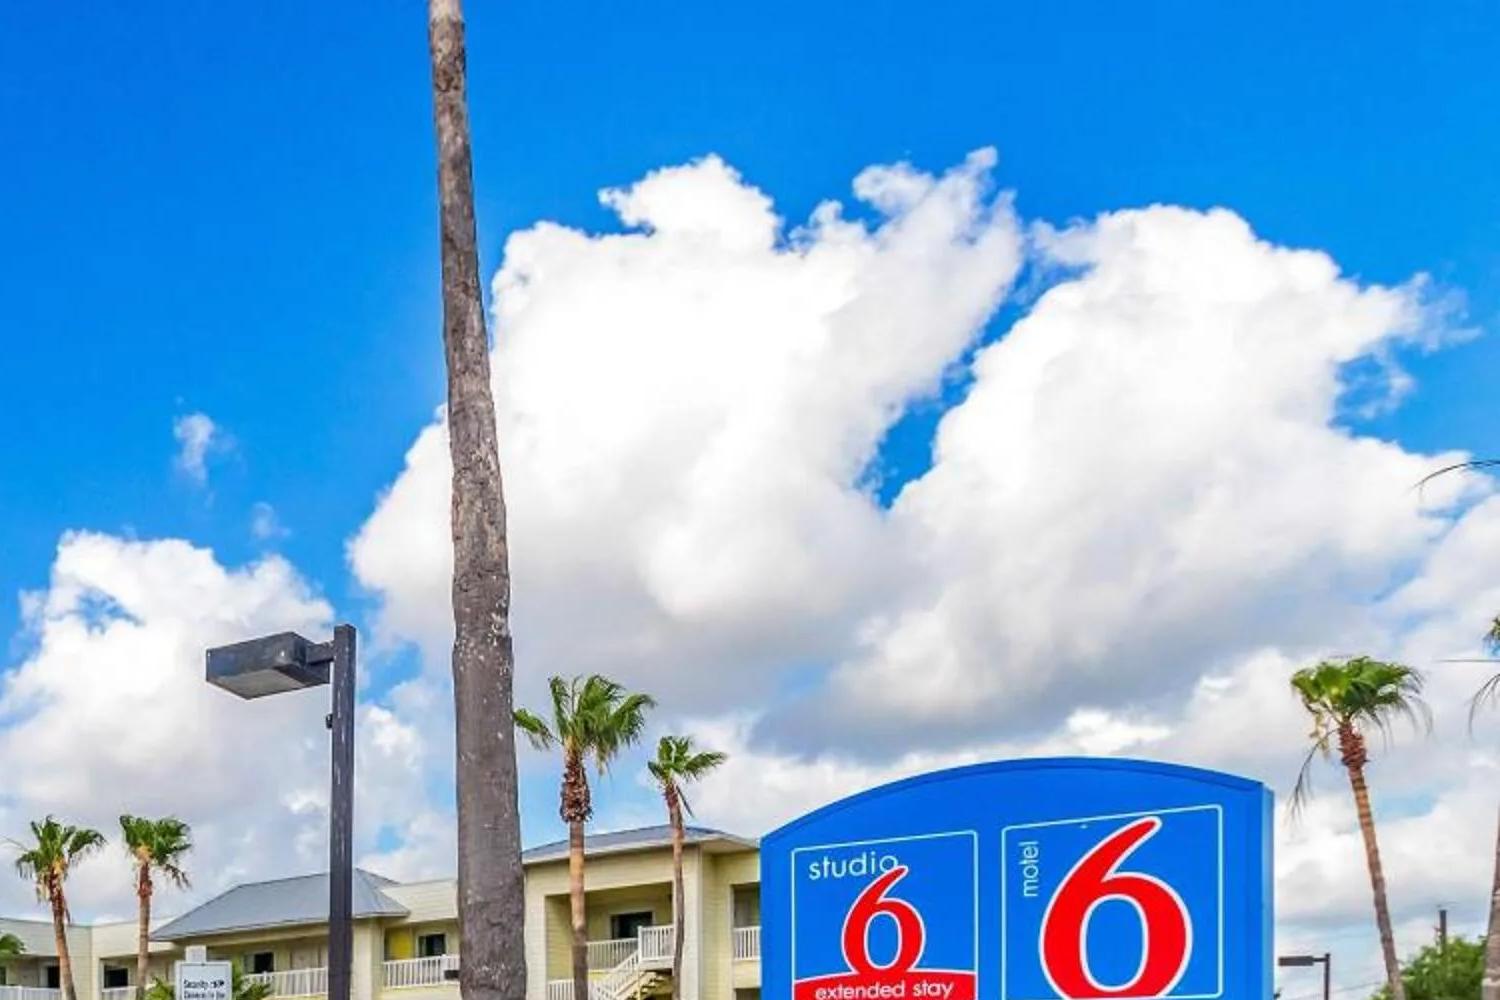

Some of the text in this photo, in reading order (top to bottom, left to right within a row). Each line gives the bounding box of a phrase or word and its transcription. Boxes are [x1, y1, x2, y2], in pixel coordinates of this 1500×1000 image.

[809, 851, 899, 880] studio
[1018, 841, 1039, 897] motel
[841, 865, 927, 973] 6
[815, 979, 955, 1000] extended stay
